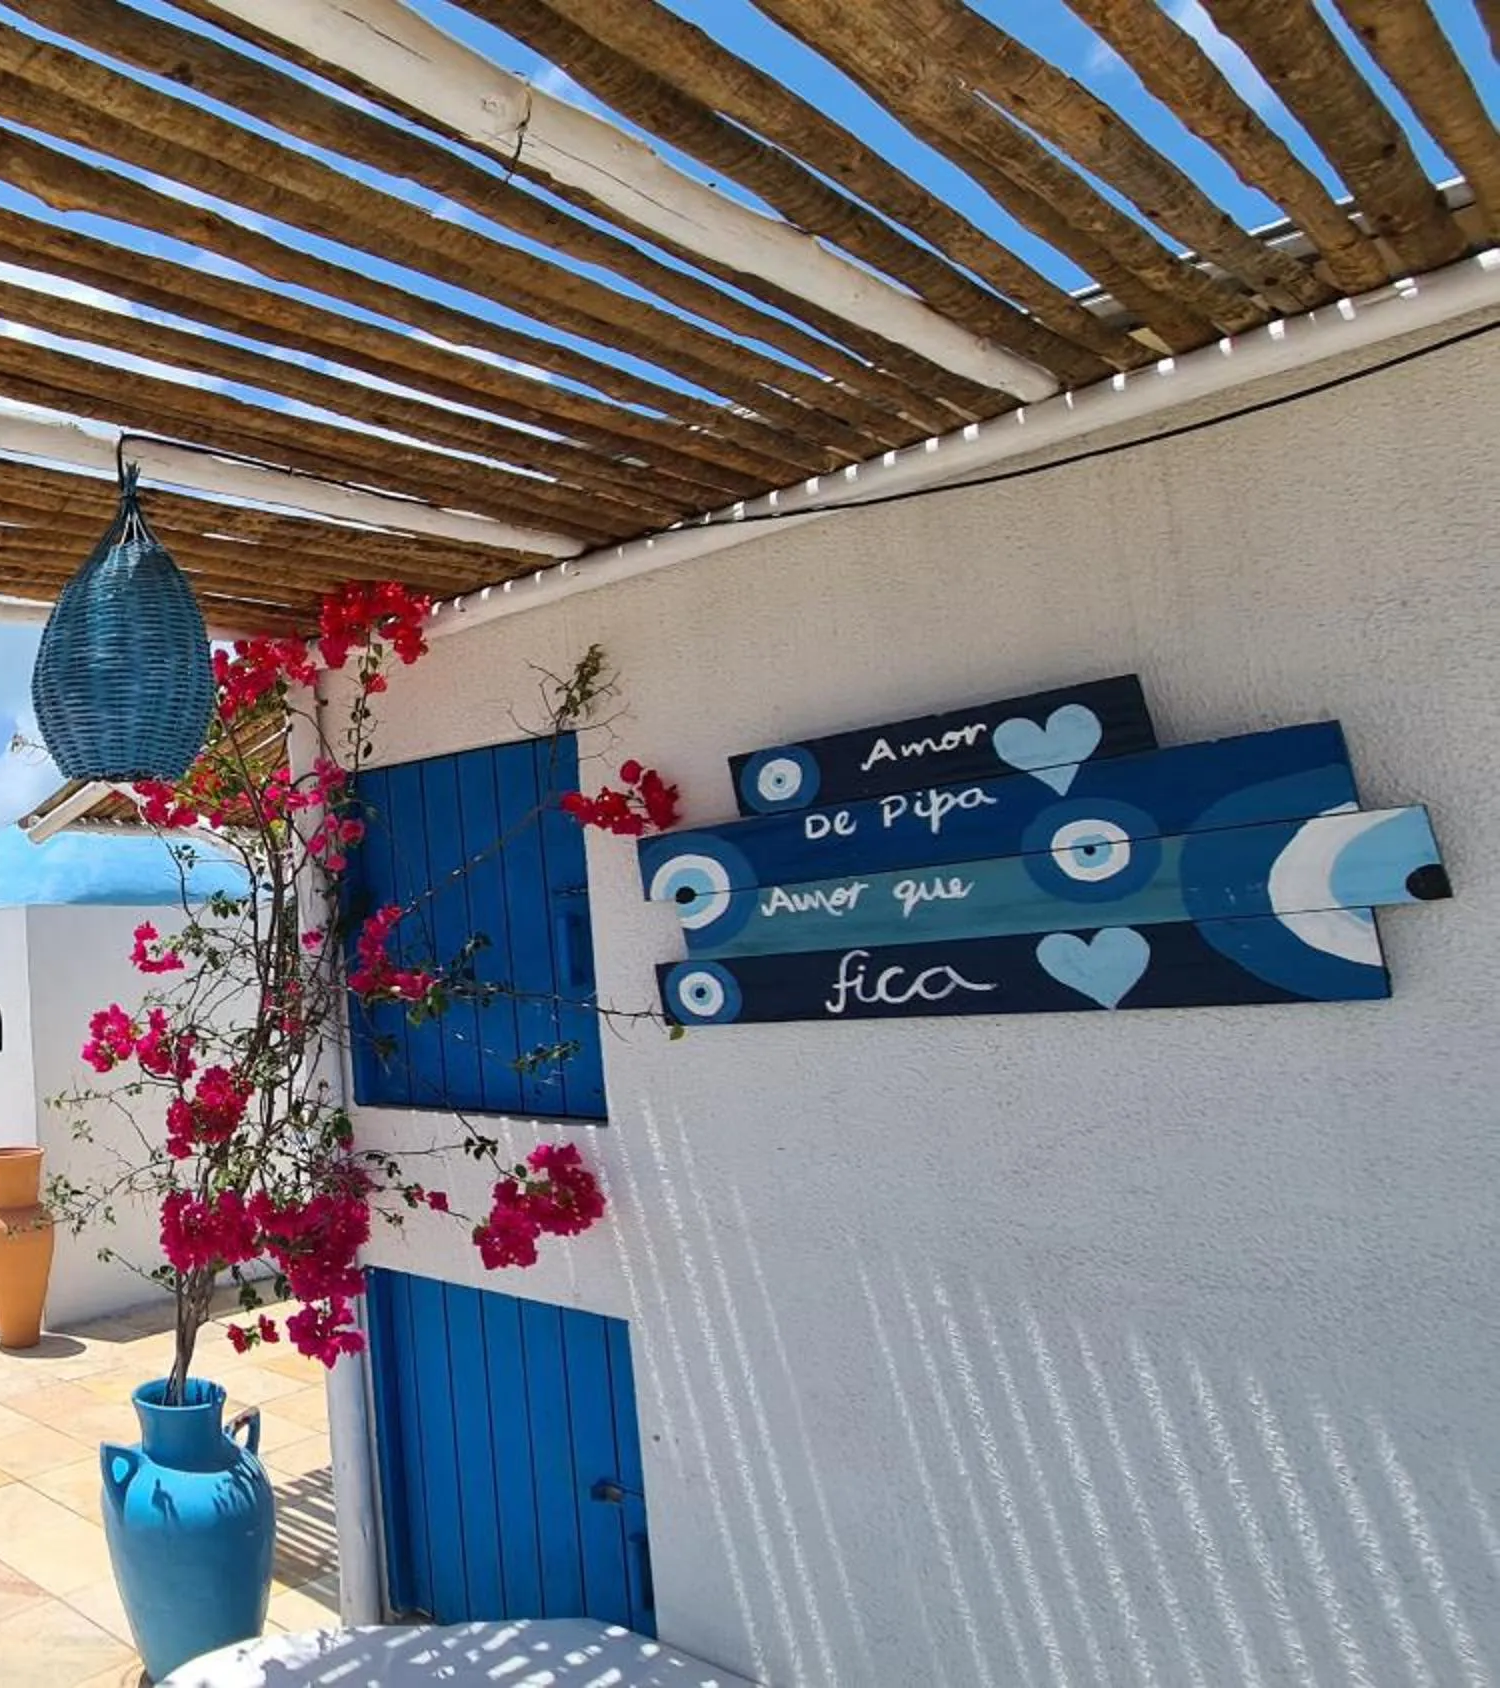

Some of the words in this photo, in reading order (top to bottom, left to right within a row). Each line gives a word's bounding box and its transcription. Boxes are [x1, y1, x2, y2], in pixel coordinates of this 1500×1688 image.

[860, 723, 987, 771] Amor
[805, 811, 856, 839] De
[880, 787, 997, 834] Pipa
[761, 881, 869, 917] Amor
[893, 877, 975, 918] que
[825, 949, 997, 1013] fica
